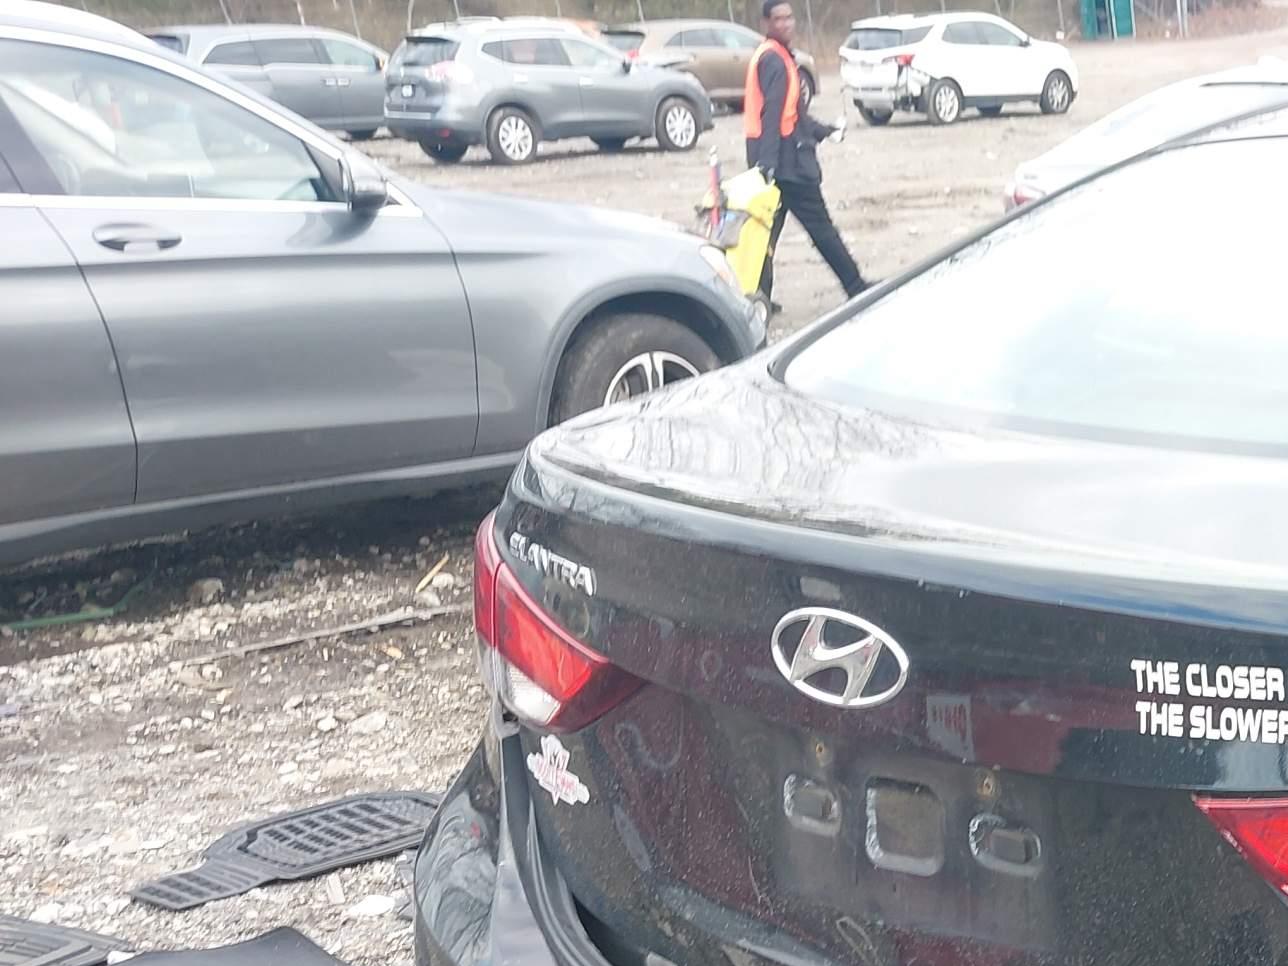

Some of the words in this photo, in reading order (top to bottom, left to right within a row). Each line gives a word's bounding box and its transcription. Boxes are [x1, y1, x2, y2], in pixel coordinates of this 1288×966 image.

[509, 531, 597, 597] ELANTRA
[1130, 658, 1180, 696] THE
[1185, 663, 1285, 702] CLOSER
[1135, 701, 1184, 738] THE
